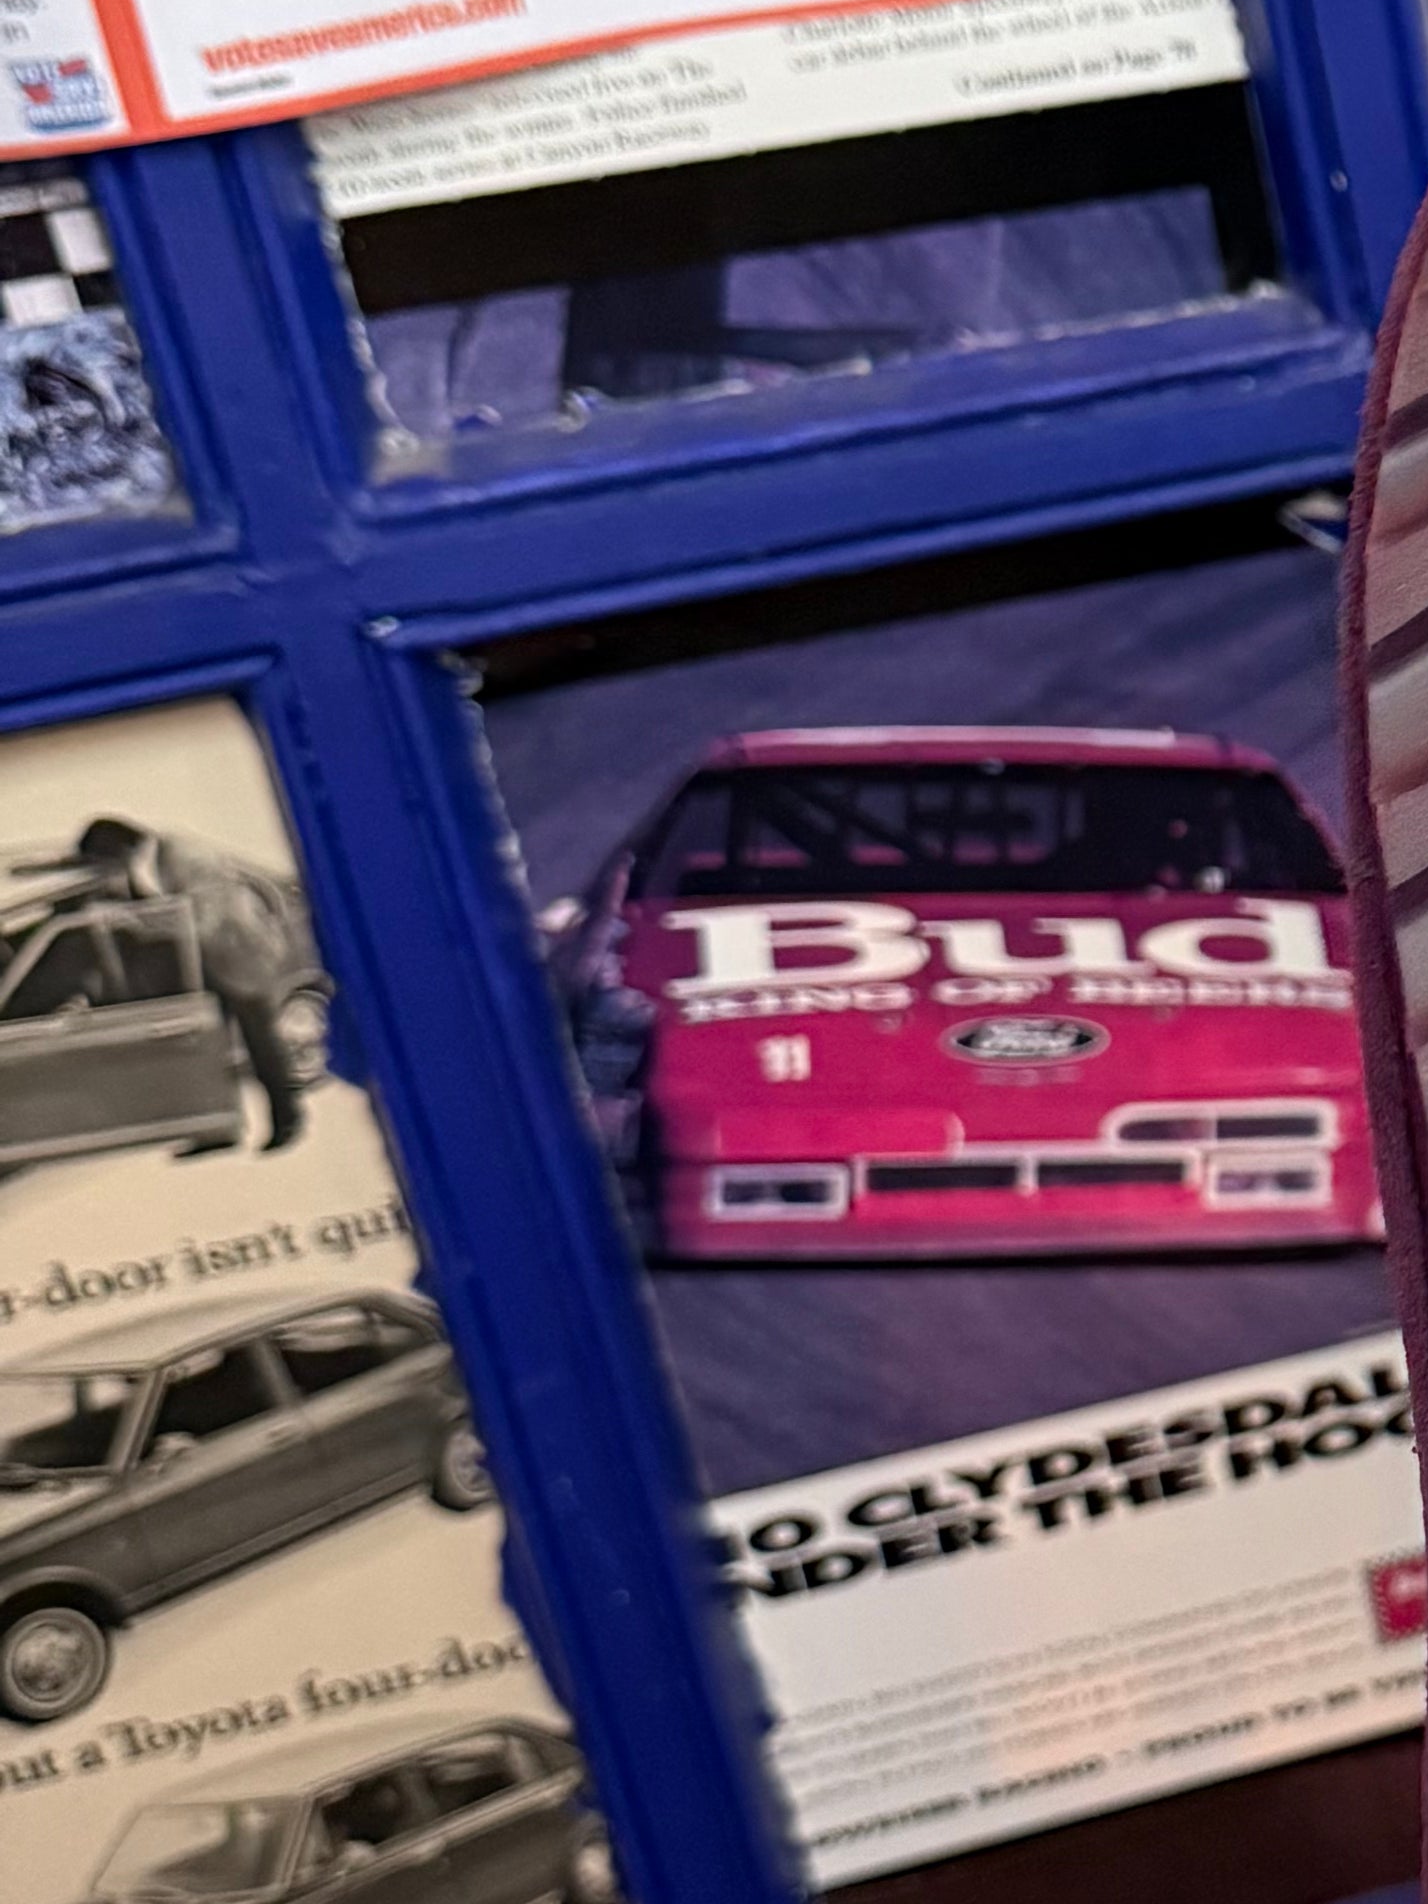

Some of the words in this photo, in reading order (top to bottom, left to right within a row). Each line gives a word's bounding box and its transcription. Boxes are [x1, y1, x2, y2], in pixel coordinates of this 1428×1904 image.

[662, 897, 1354, 1000] Bud
[679, 982, 915, 1023] KING
[934, 973, 1052, 1004] OF
[1069, 975, 1354, 1011] BEERS
[180, 1222, 300, 1276] isn't
[1022, 1462, 1217, 1534] THE
[748, 1514, 816, 1555] O
[75, 1739, 106, 1772] a
[106, 1692, 292, 1764] Toyota
